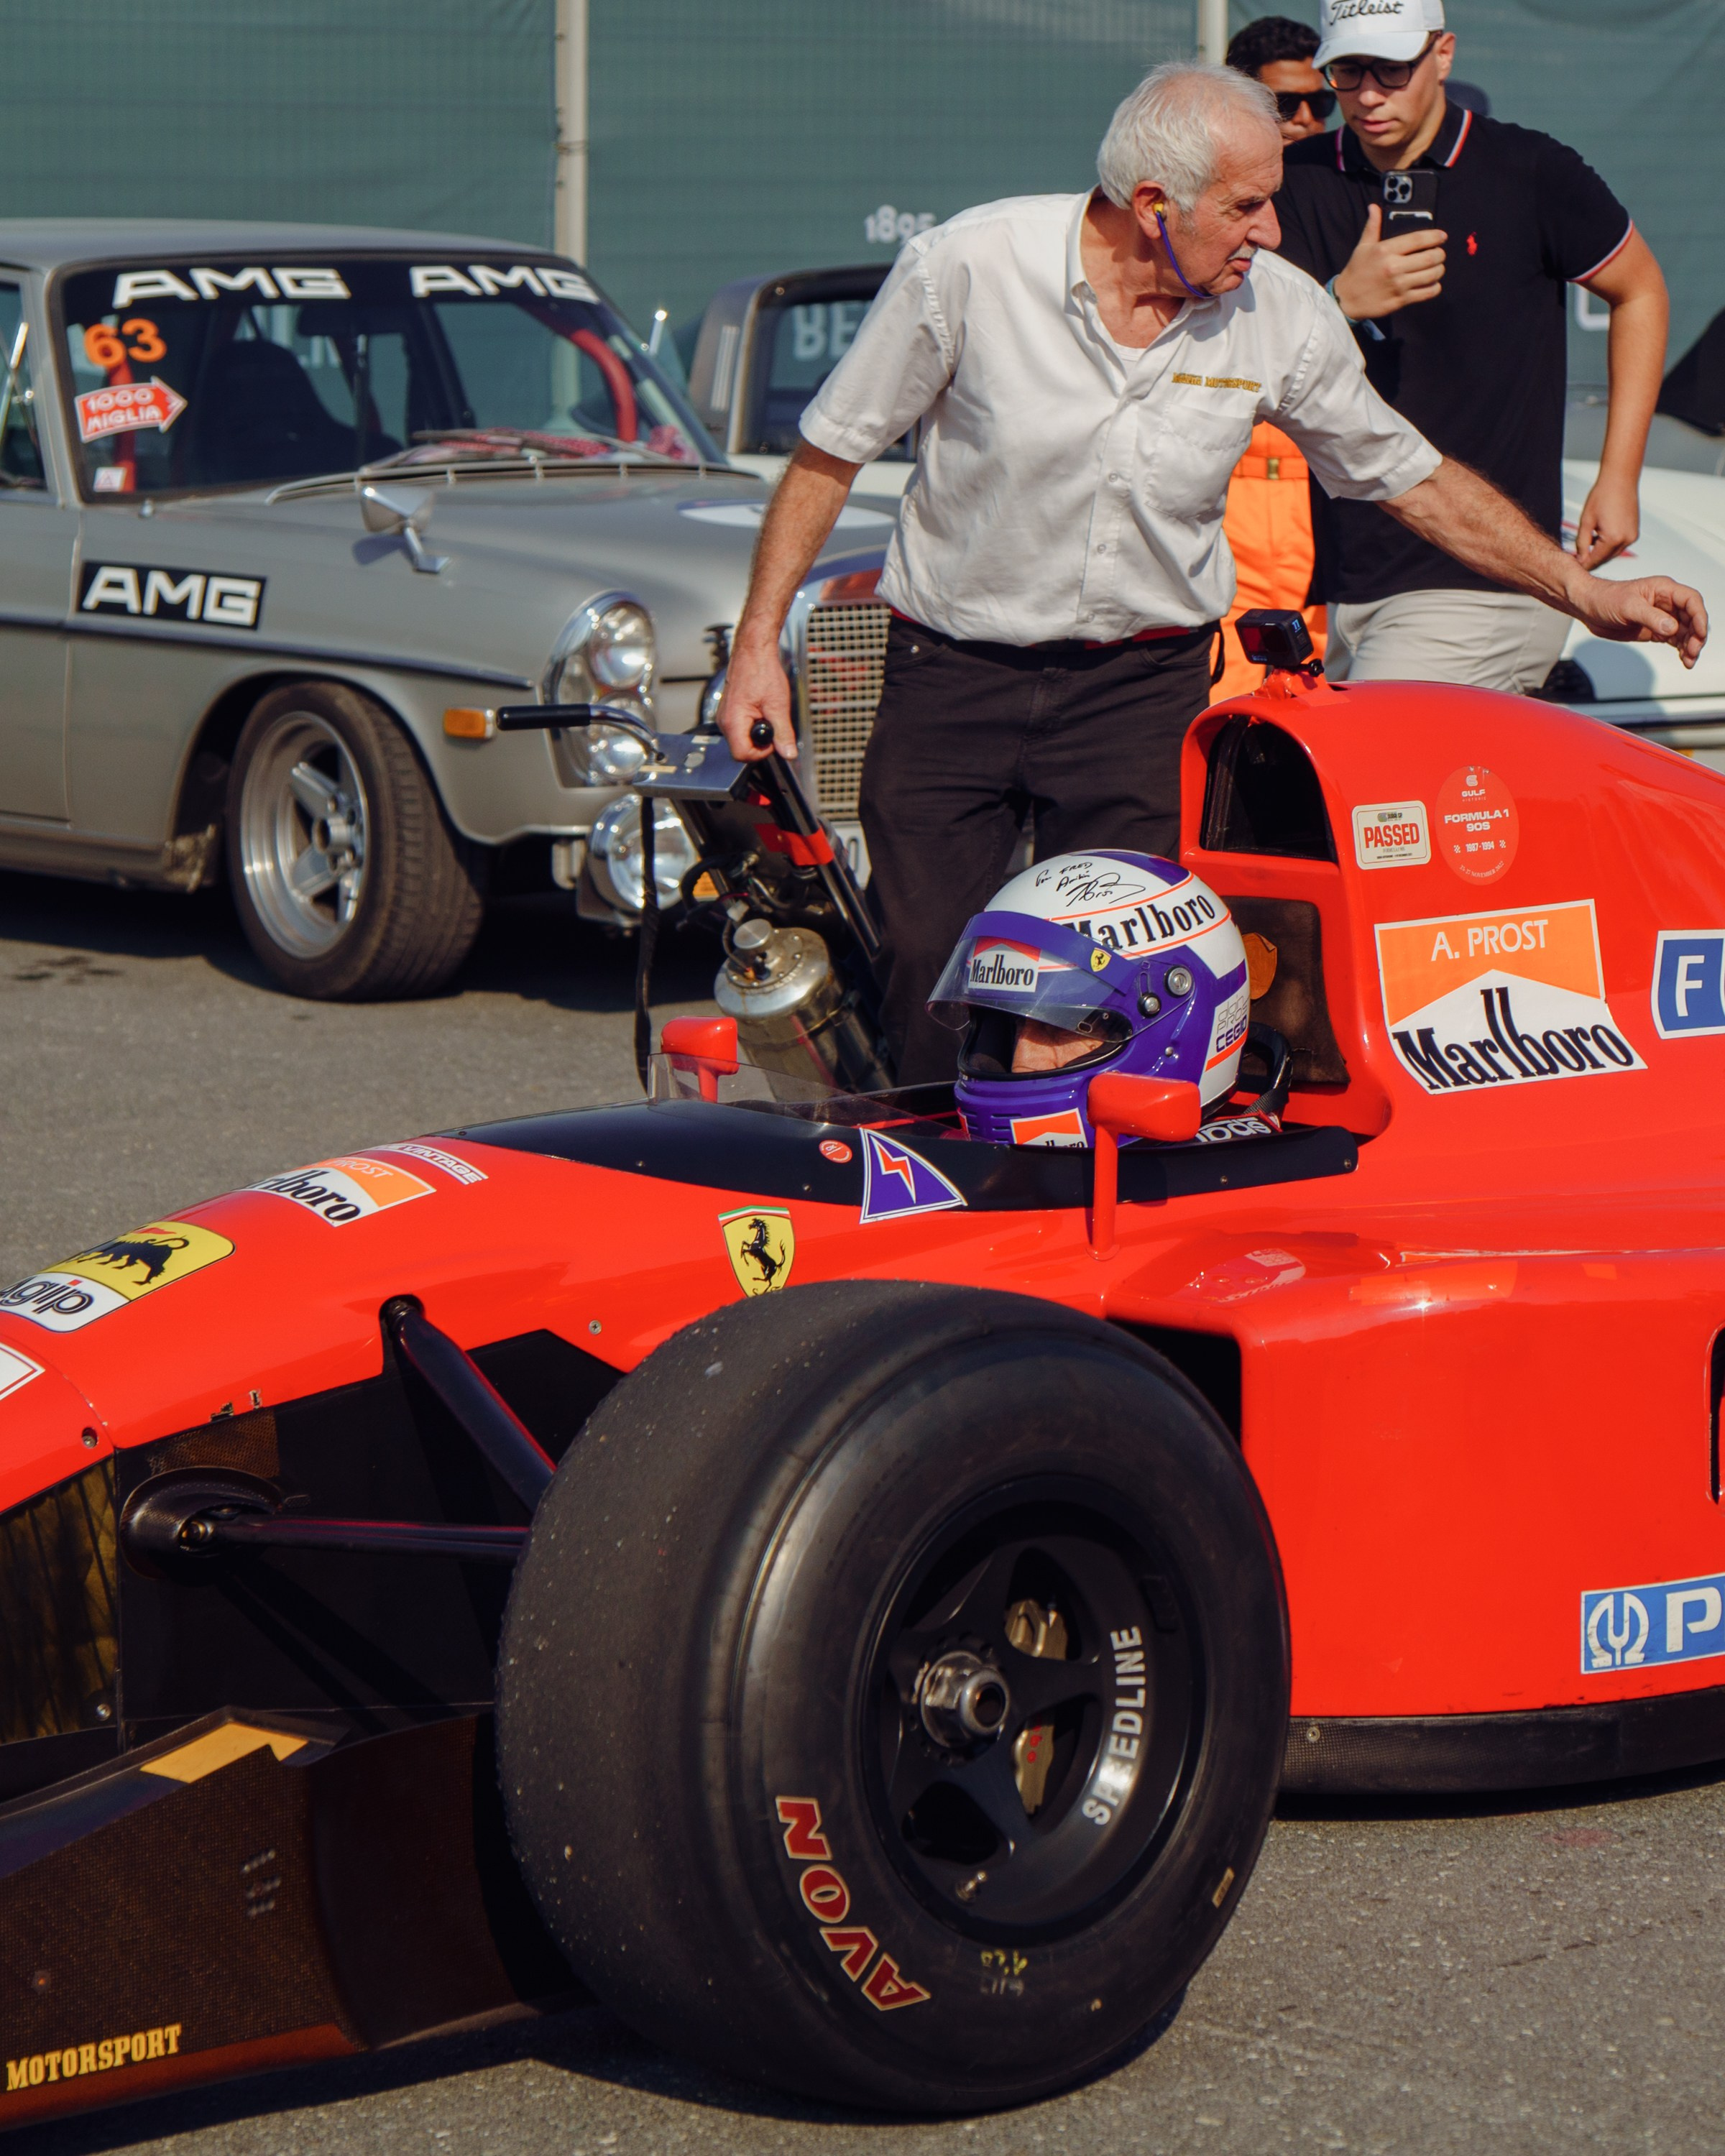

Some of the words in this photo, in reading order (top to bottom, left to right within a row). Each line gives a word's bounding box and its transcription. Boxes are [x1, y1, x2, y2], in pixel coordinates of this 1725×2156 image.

[112, 267, 351, 308] AMG
[410, 266, 601, 305] AMG
[84, 318, 167, 369] 63
[86, 388, 155, 413] 1000
[86, 405, 162, 433] MIGLIA
[83, 566, 262, 627] AMG
[1364, 822, 1420, 849] PASSED
[1445, 809, 1502, 824] FORMULA
[1503, 808, 1509, 818] 1
[1431, 931, 1460, 962] A.
[1468, 919, 1548, 956] PROST
[970, 954, 1034, 986] Marlboro
[1393, 987, 1634, 1090] Marlboro
[402, 1143, 483, 1184] VINTAGE
[1082, 1625, 1146, 1826] SPEEDLINE
[775, 1795, 931, 2011] AVON
[6, 2023, 181, 2091] MOTORSPORT
